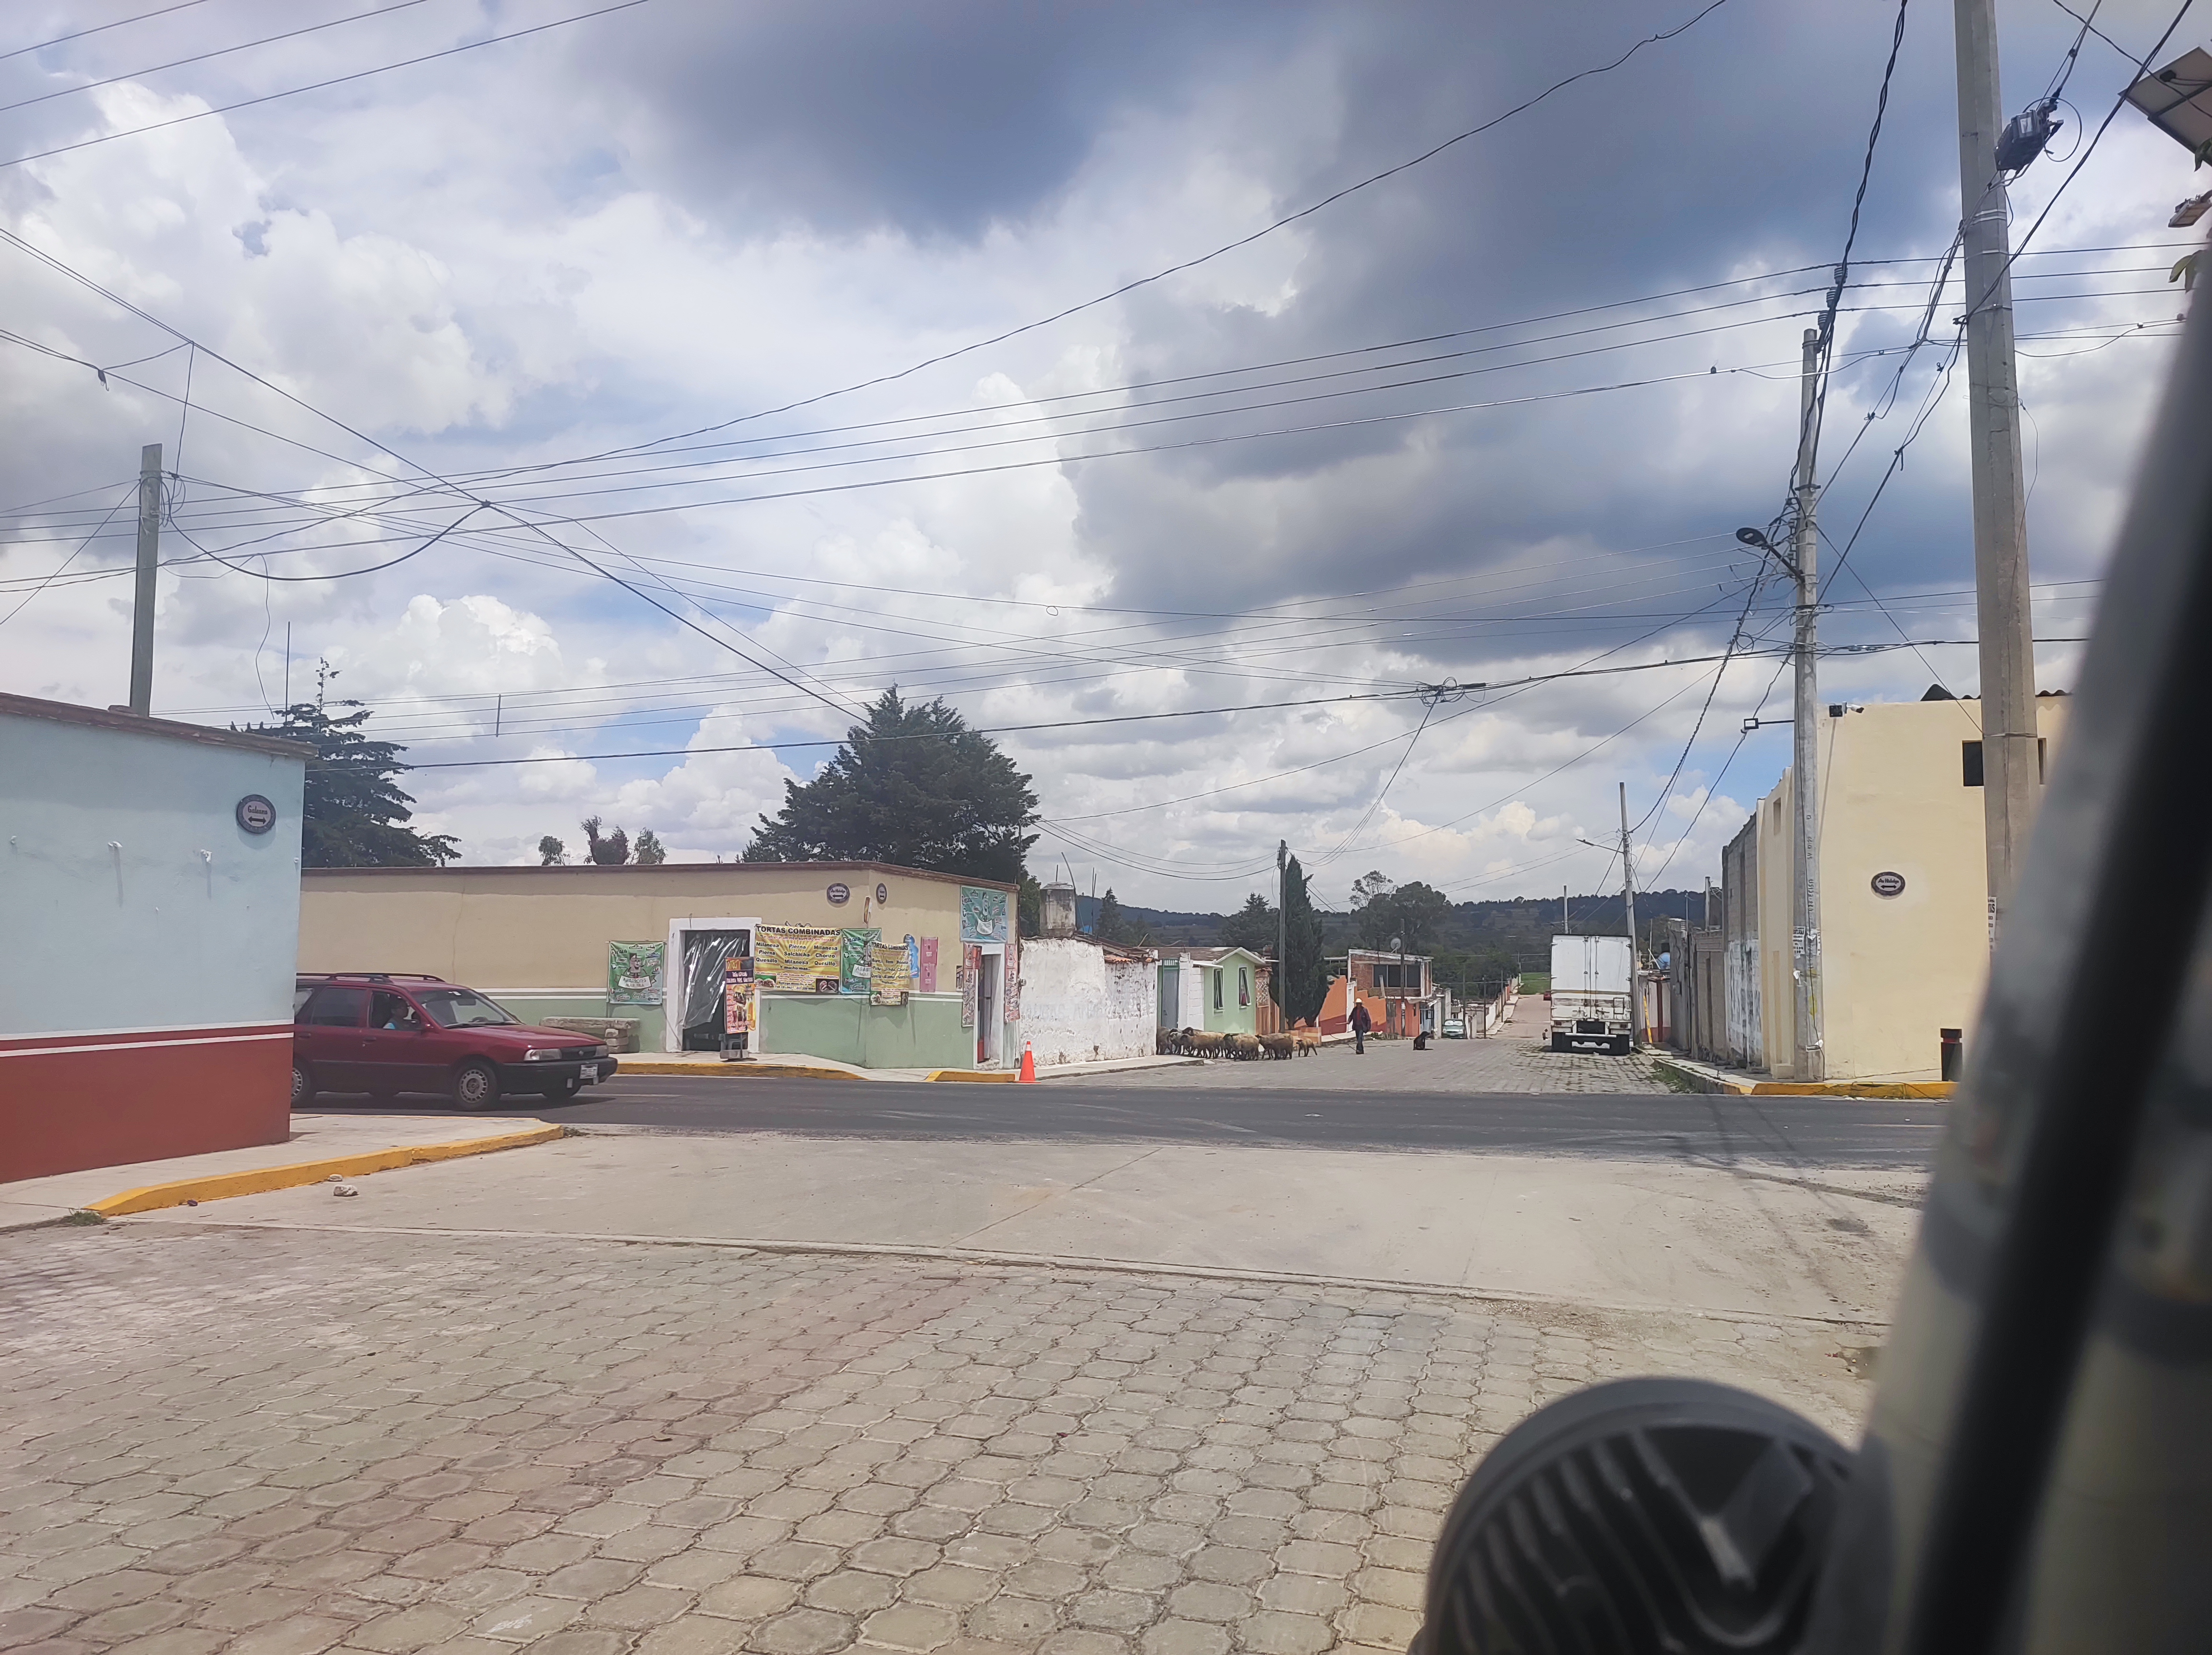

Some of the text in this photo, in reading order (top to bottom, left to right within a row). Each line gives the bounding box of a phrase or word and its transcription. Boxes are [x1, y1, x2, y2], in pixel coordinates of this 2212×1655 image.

[248, 805, 267, 815] Galeana
[756, 926, 841, 936] TORTAS COMBINADAS
